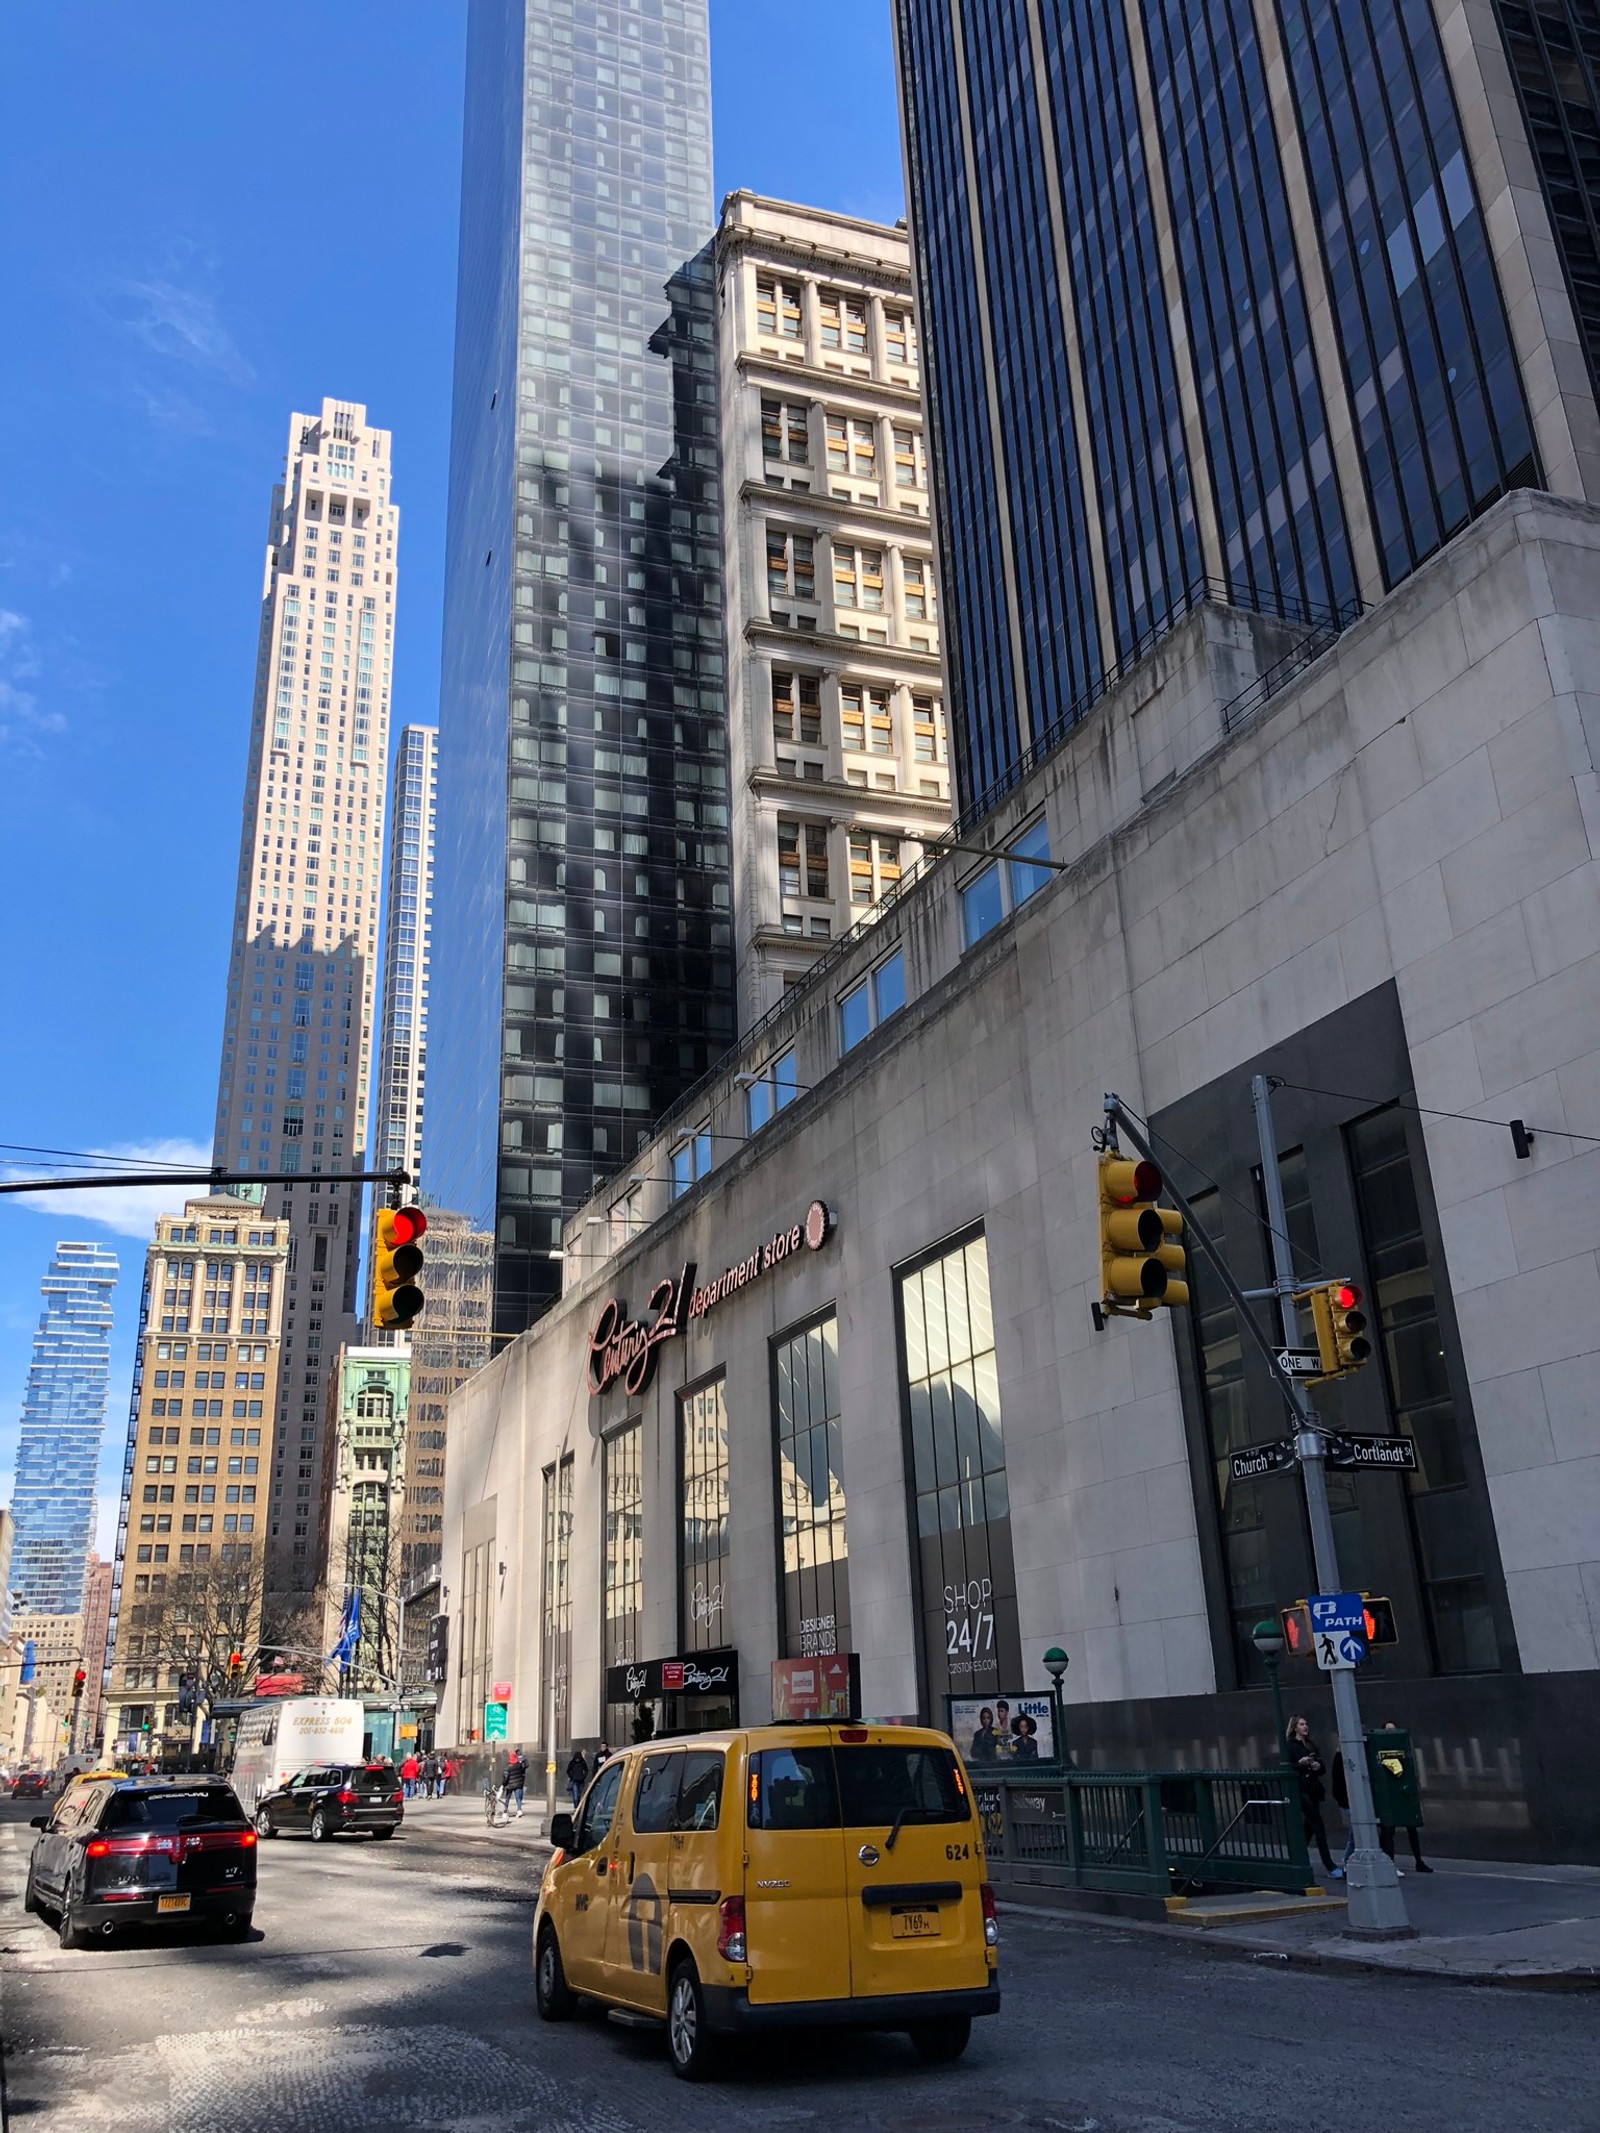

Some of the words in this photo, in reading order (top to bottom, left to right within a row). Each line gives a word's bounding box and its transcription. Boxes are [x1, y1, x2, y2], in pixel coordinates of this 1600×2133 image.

[688, 1249, 762, 1319] department
[763, 1223, 802, 1271] store
[587, 1298, 649, 1396] Century
[648, 1262, 692, 1346] 21
[1281, 1357, 1302, 1369] ONE
[1354, 1443, 1405, 1463] Cortlandt
[1233, 1454, 1268, 1477] Church
[943, 1578, 992, 1614] SHOP
[800, 1614, 836, 1634] DESIGNER
[1325, 1616, 1363, 1628] PATH
[800, 1630, 837, 1652] BRANDS
[946, 1611, 994, 1658] 24/7
[710, 1666, 730, 1682] 21
[1018, 1701, 1049, 1714] Little
[292, 1716, 331, 1726] EXPRESS
[945, 1843, 969, 1860] 624
